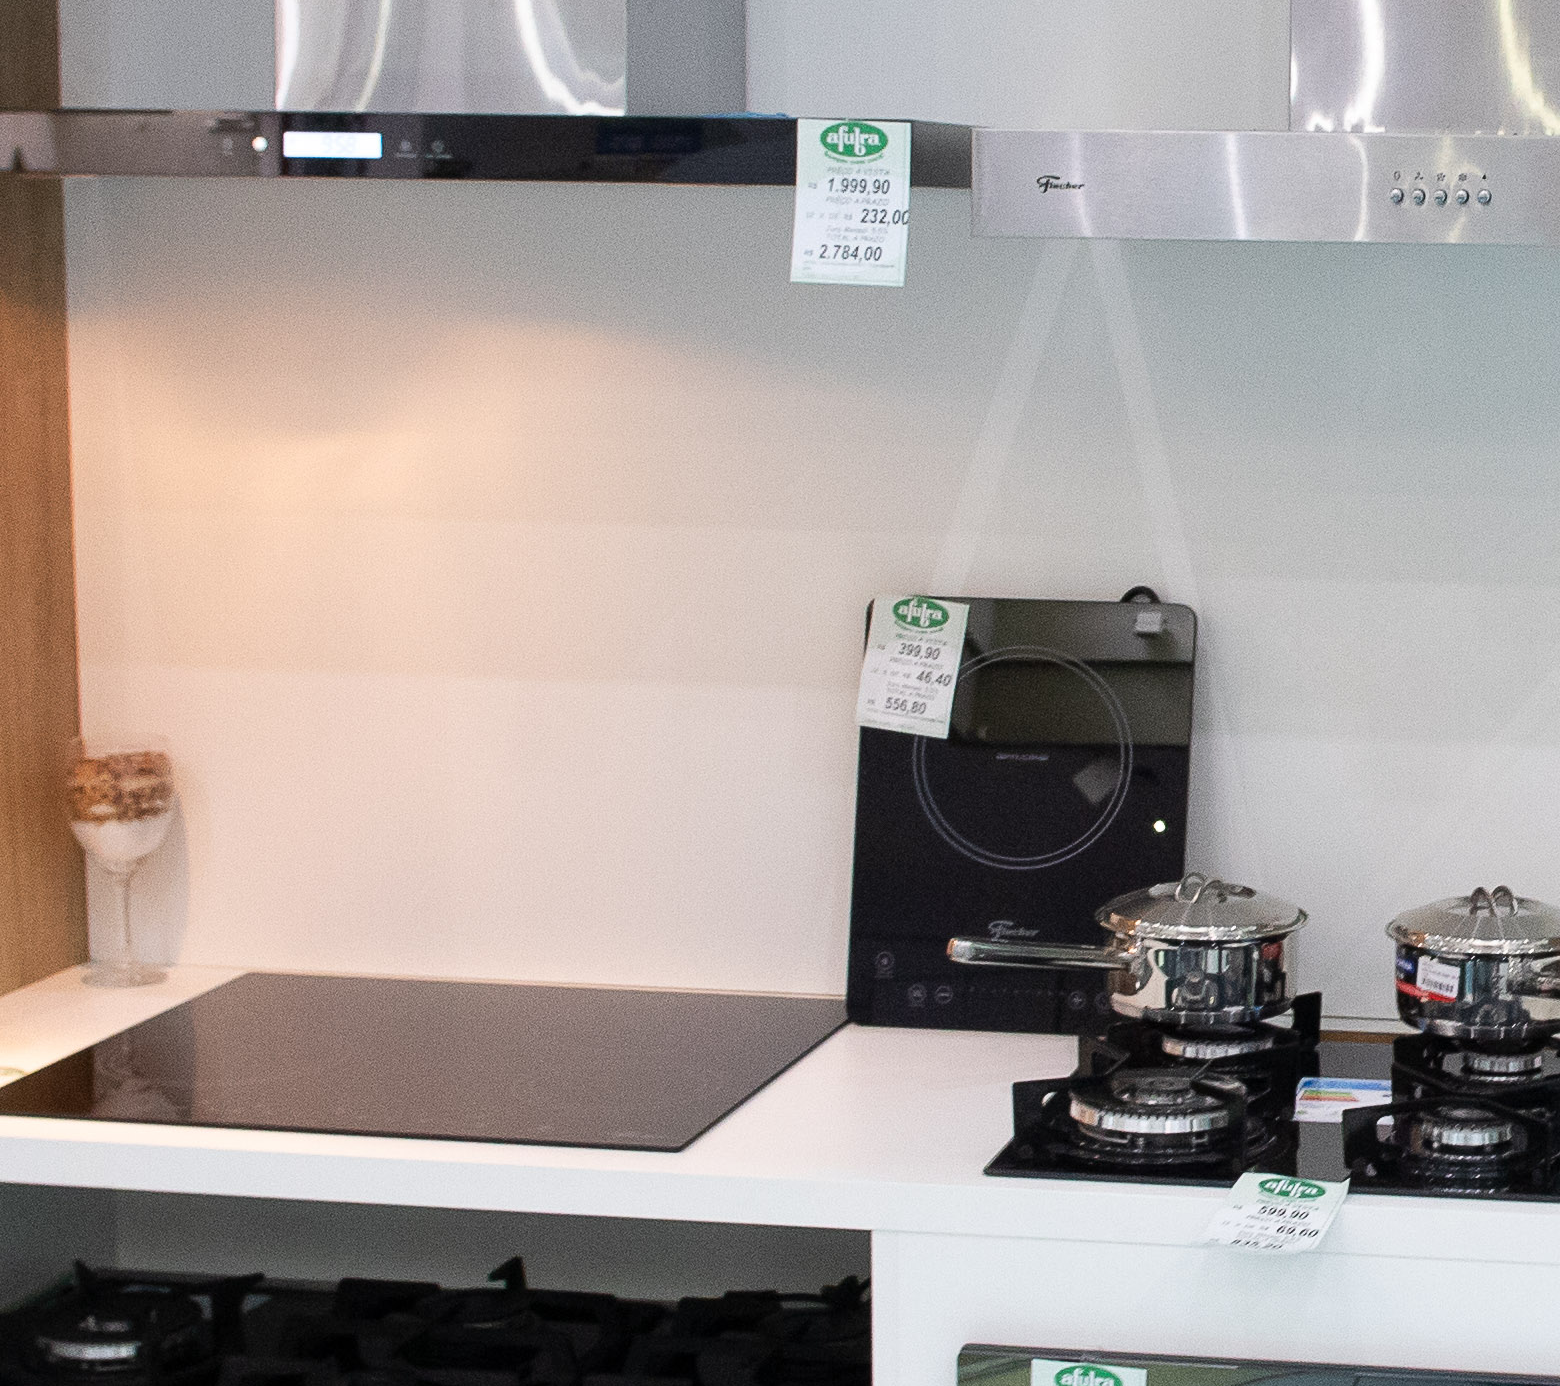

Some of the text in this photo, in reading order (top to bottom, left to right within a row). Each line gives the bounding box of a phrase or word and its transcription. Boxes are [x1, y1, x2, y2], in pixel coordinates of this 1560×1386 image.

[828, 178, 890, 196] 1.999,90
[819, 244, 882, 262] 2.784,00
[899, 642, 941, 660] 399,90
[916, 670, 952, 687] 46,40
[885, 697, 927, 714] 556,80
[1257, 1205, 1310, 1220] 599,90
[1276, 1225, 1320, 1238] 69,60
